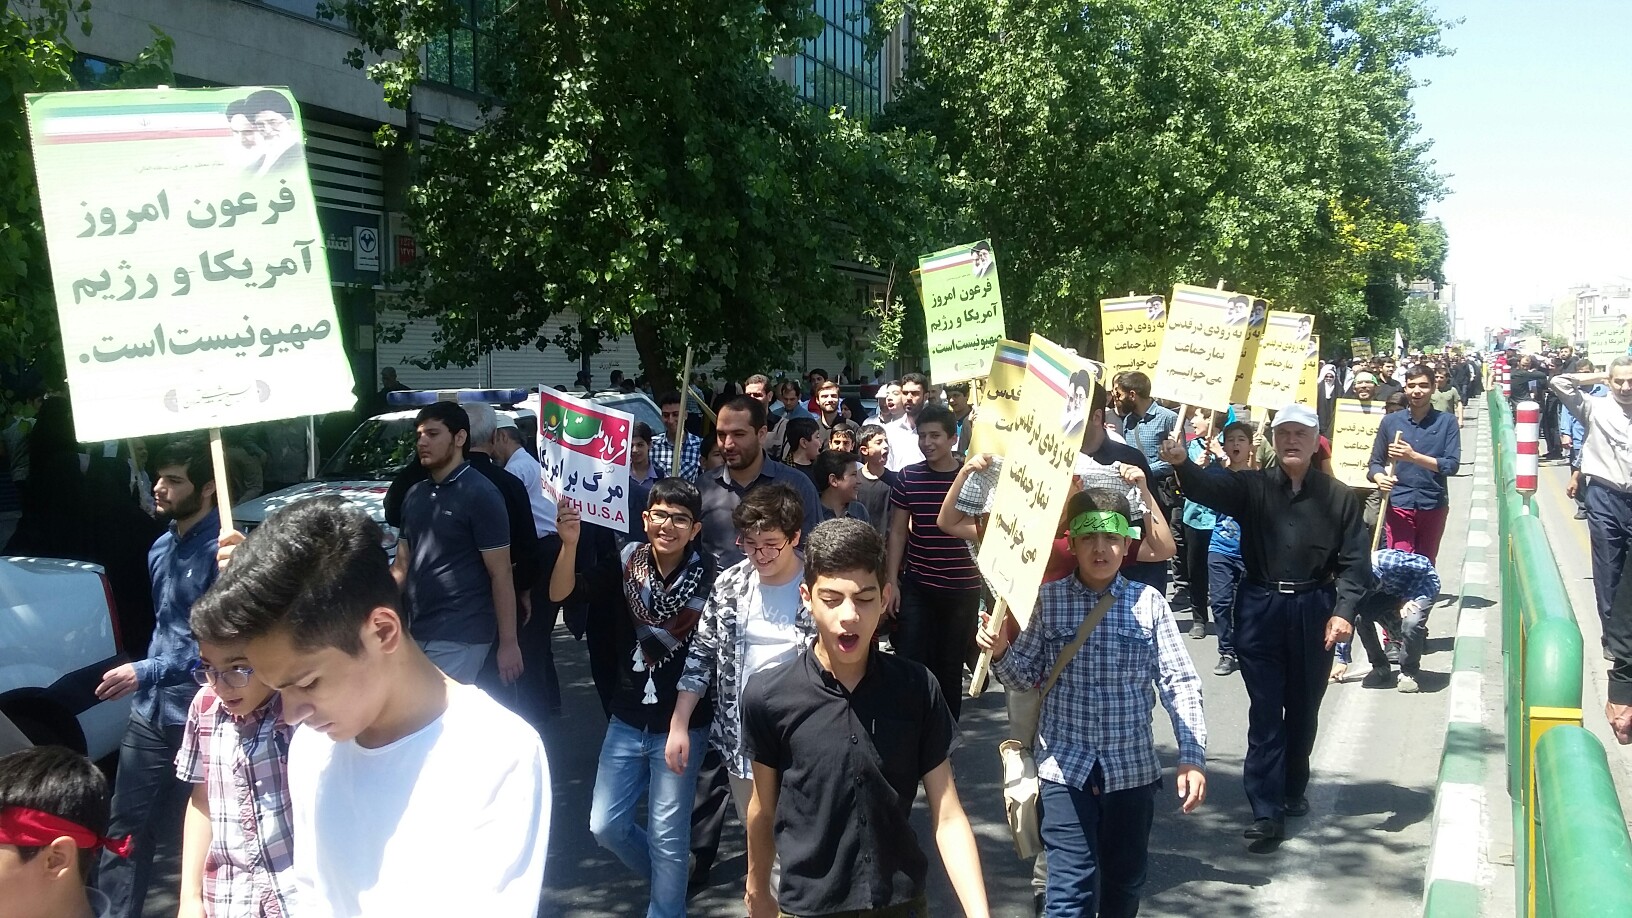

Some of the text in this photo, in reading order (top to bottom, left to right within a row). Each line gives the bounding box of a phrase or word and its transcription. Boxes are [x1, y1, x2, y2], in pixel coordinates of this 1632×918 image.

[76, 178, 296, 238] فرعون امروز
[72, 239, 315, 304] آمریکا و رژیم
[931, 278, 992, 308] فرعون امروز
[931, 302, 998, 333] آمریکا و رژیم
[1105, 320, 1165, 335] به زودی در قدس
[1168, 318, 1193, 331] قدس
[1191, 321, 1203, 335] در
[1204, 324, 1231, 340] زودی
[1232, 329, 1243, 342] به
[1114, 339, 1157, 351] نماز جماعت
[1174, 343, 1225, 361] نماز جماعت
[1206, 375, 1223, 385] می
[1015, 408, 1036, 434] قدس
[1028, 423, 1042, 446] در
[1038, 433, 1065, 470] زودی
[1343, 441, 1370, 451] جماعت
[1064, 447, 1075, 476] به
[564, 470, 578, 492] بر
[582, 472, 624, 503] مرگ
[1009, 460, 1052, 510] نماز جماعت
[587, 502, 625, 523] U.S.A
[1021, 545, 1037, 564] می
